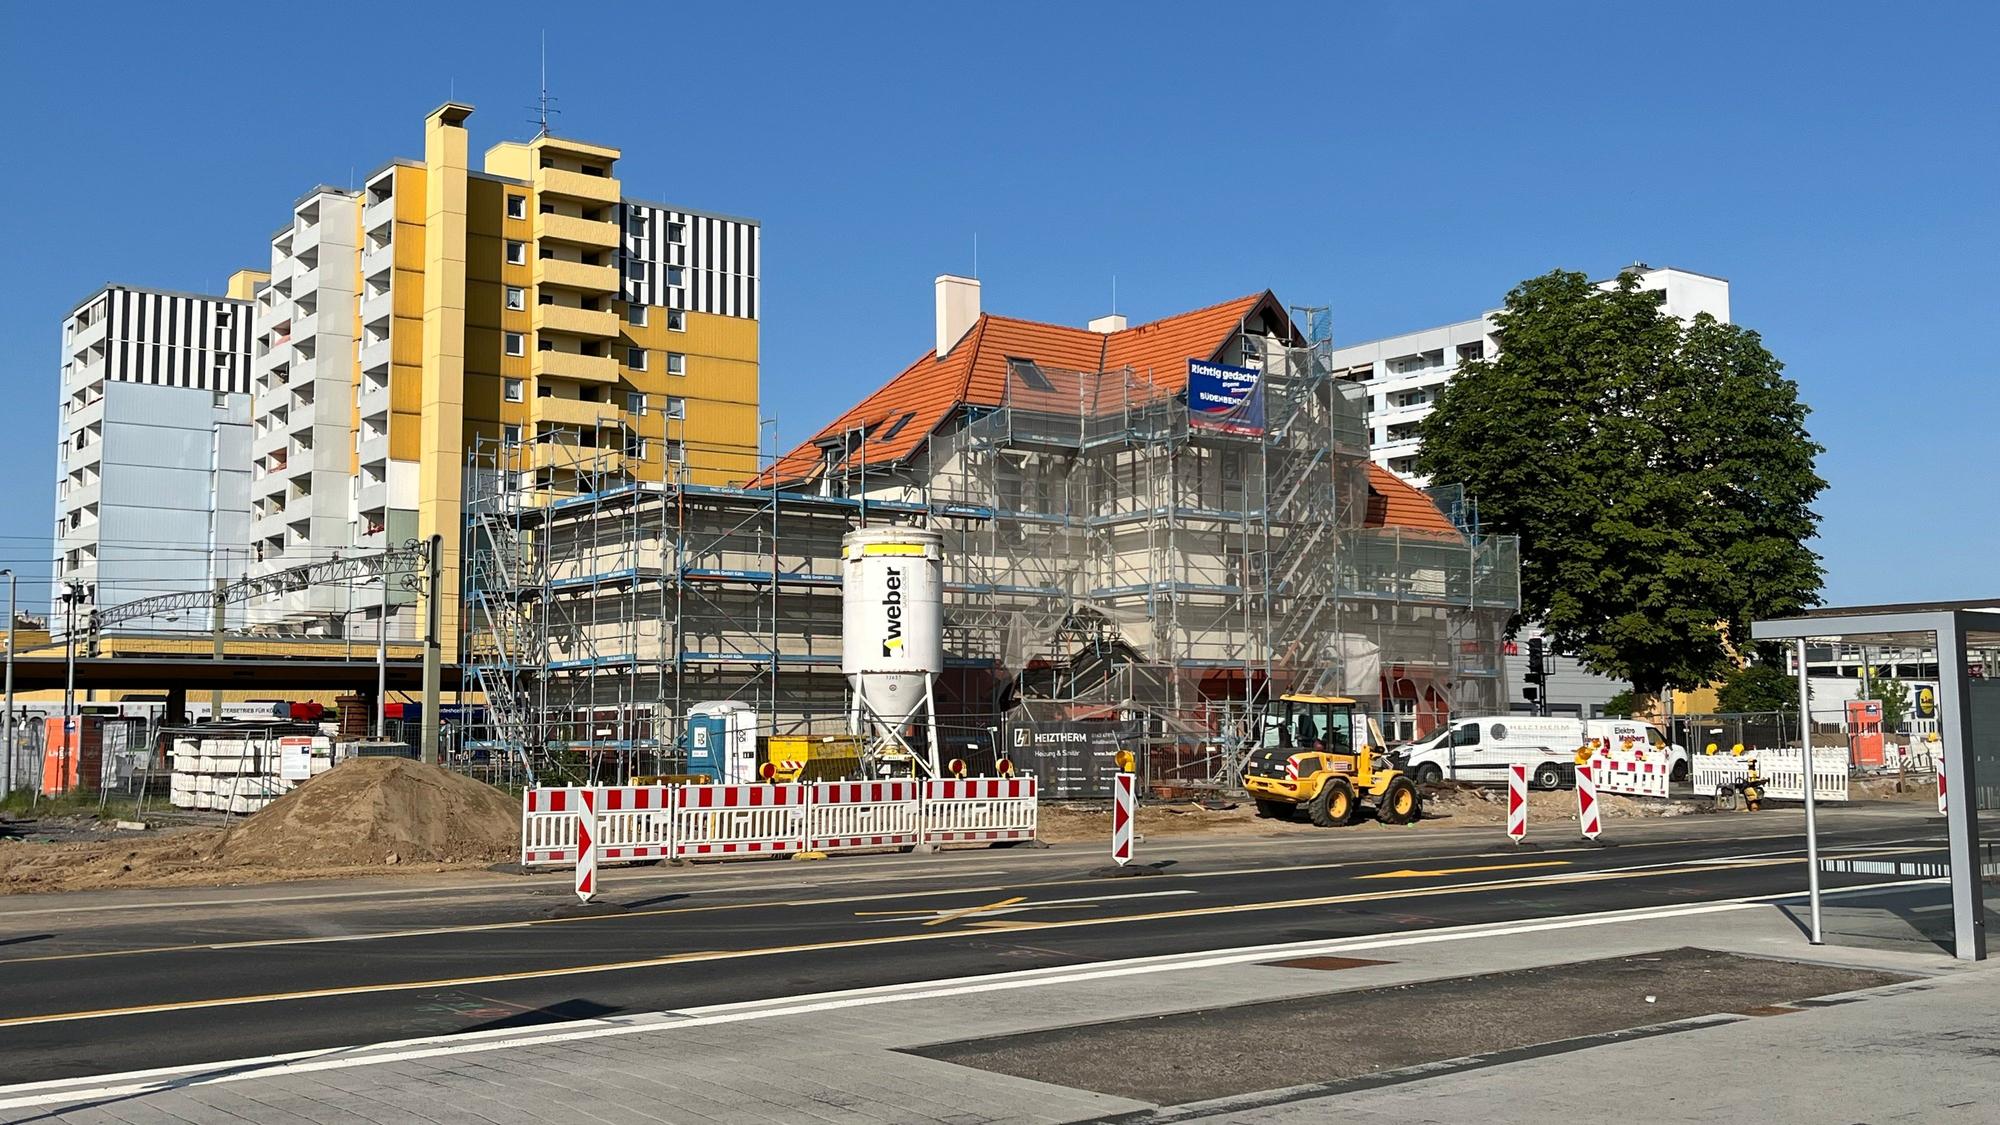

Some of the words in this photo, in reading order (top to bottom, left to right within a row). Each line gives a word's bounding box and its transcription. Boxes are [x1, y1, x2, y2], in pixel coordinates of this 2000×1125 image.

[1191, 364, 1221, 379] Richtig
[1222, 370, 1258, 383] gedacht
[882, 566, 901, 640] weber
[1034, 732, 1087, 742] HEIZTHERM
[1614, 727, 1635, 735] Elektro
